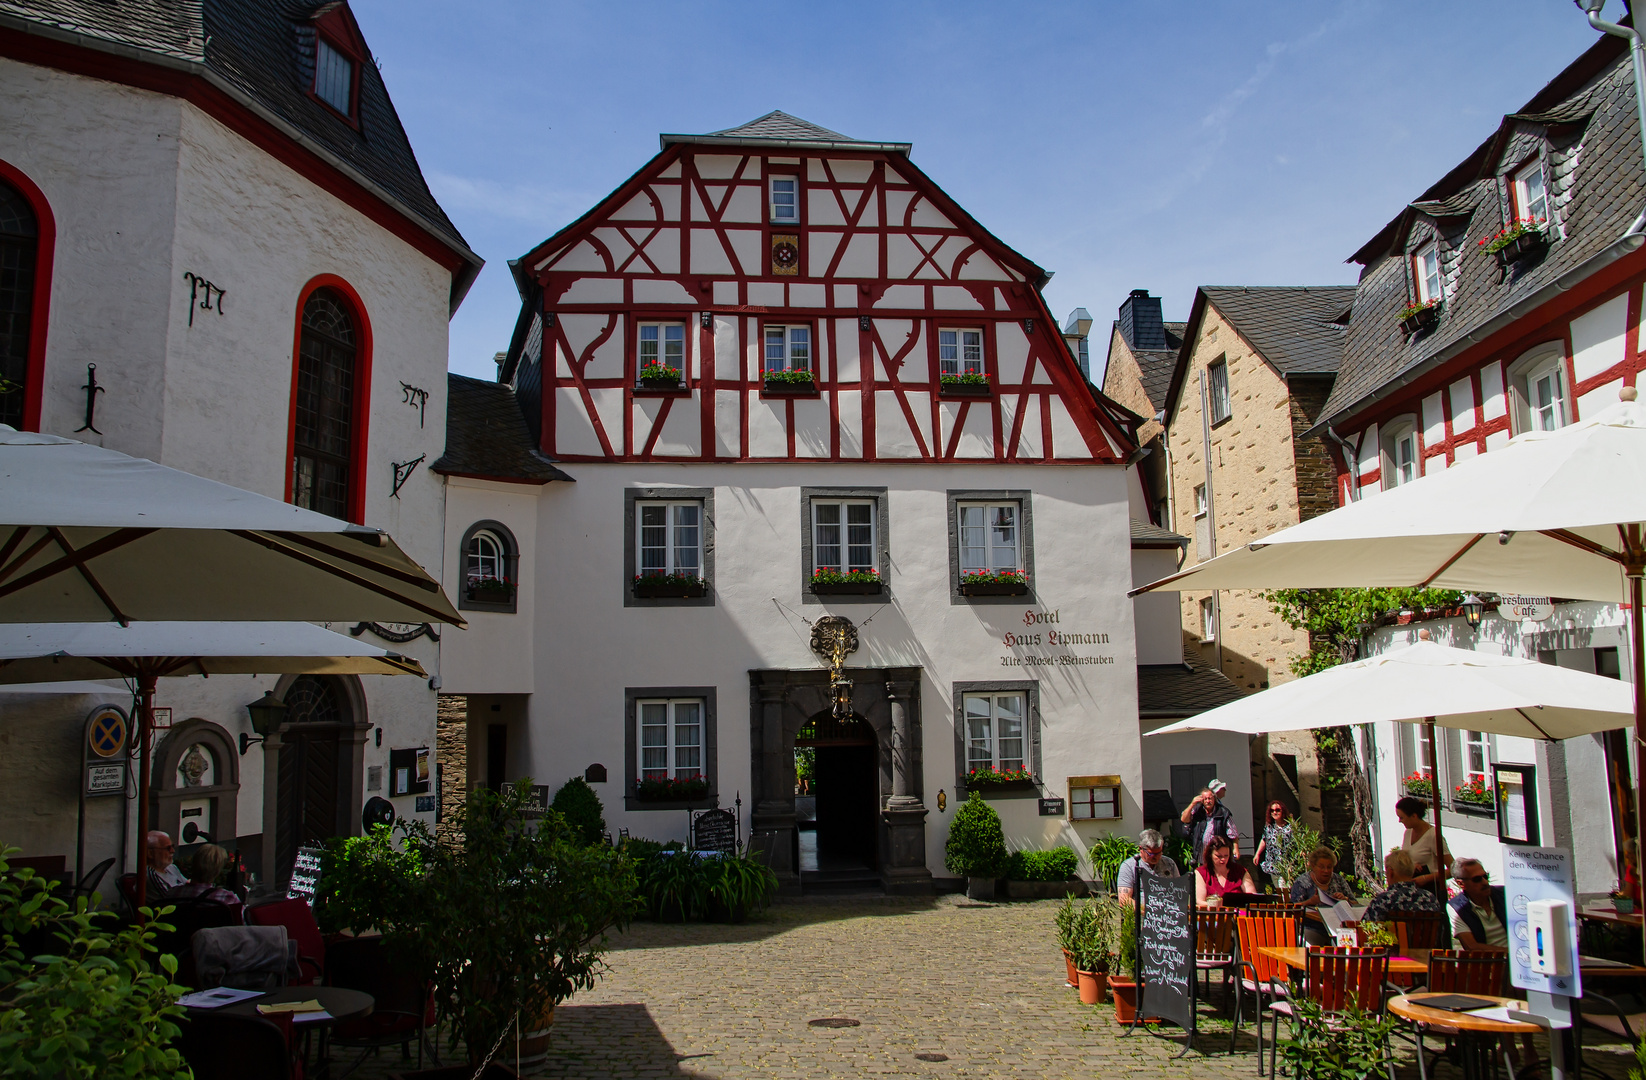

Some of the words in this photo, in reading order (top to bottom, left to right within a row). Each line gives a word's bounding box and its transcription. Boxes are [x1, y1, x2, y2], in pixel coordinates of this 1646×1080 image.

[1023, 609, 1060, 627] Hotel
[1003, 632, 1042, 649] Haus
[1048, 630, 1110, 647] Lipmann
[1000, 656, 1021, 667] Alte
[93, 774, 119, 782] gesamten
[92, 781, 120, 789] Marktplatz
[1508, 850, 1531, 859] Keine
[1533, 851, 1565, 861] Chance
[1509, 860, 1525, 869] den
[1527, 862, 1560, 871] Keimen!
